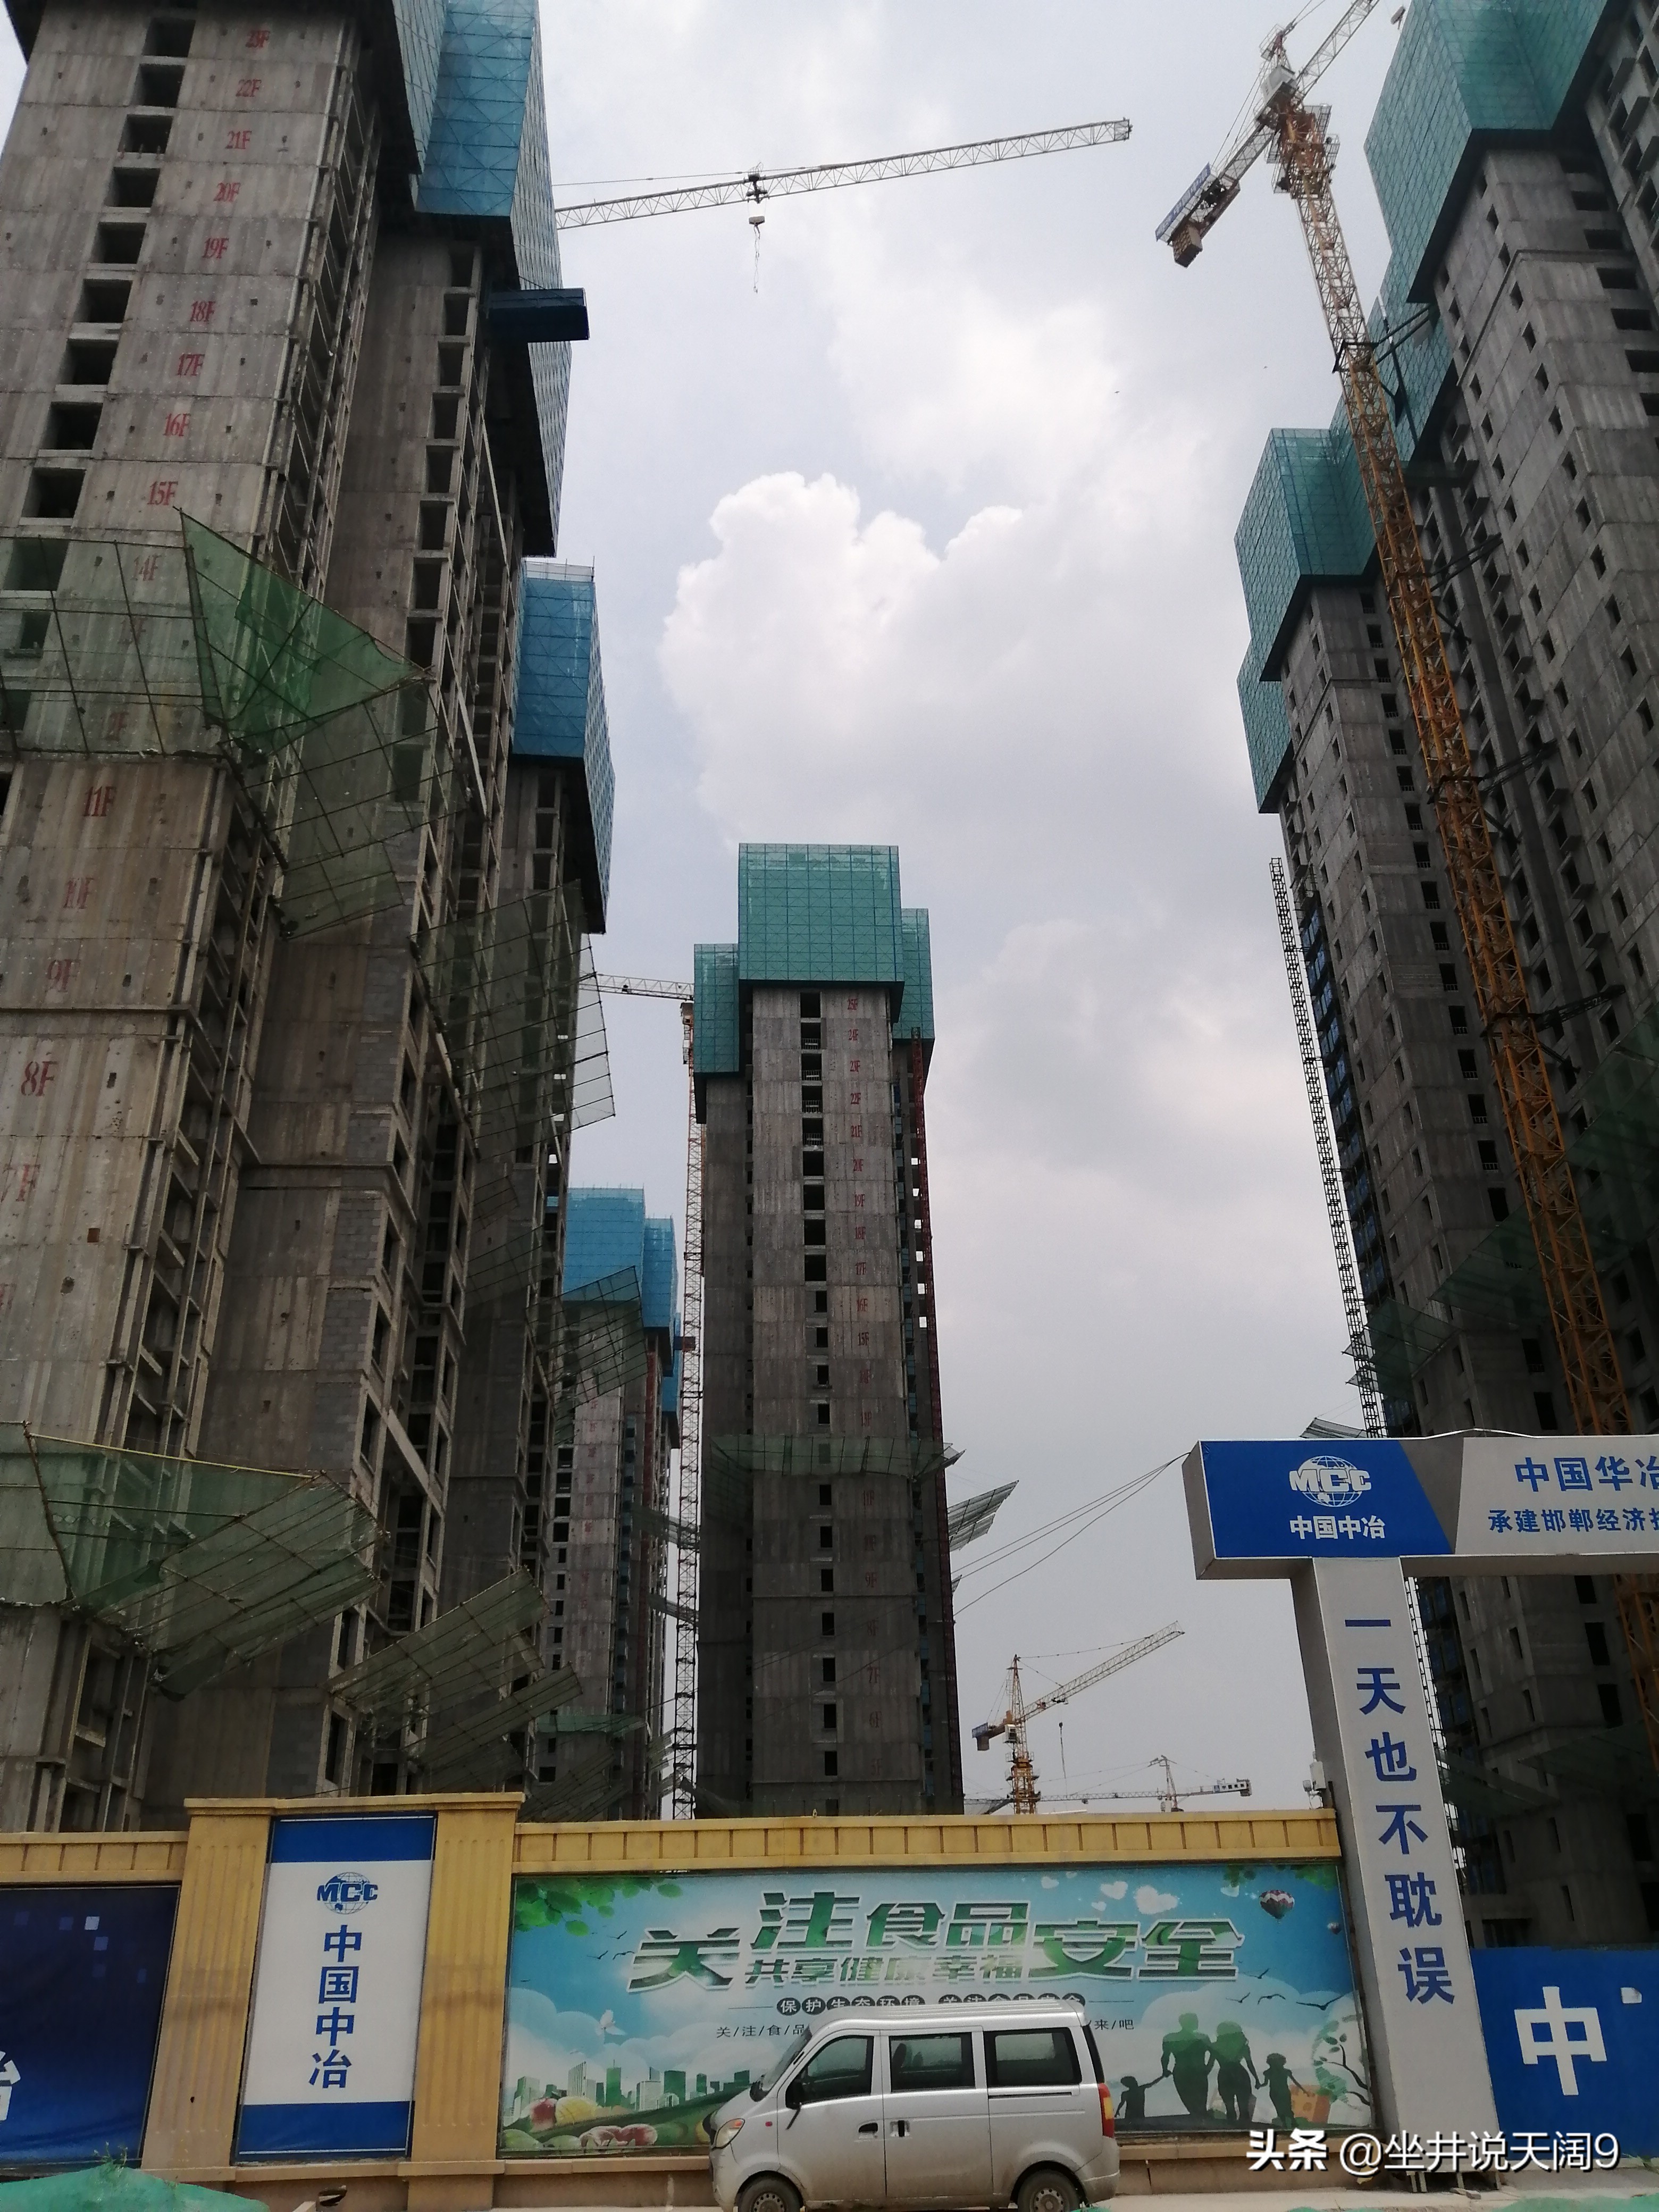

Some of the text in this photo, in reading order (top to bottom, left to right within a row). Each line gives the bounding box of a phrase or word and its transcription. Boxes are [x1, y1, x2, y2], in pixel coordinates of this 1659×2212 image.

[236, 79, 262, 97] 22F
[224, 130, 252, 150] 21F
[214, 182, 241, 203] 20F
[202, 238, 229, 259] 19F
[189, 301, 216, 322] 18F
[178, 354, 205, 376] 17F
[163, 413, 191, 437] 16F
[147, 481, 179, 506] 15F
[83, 786, 116, 817] 11F
[21, 1061, 57, 1096] 8F
[851, 1093, 861, 1105] 22F
[851, 1125, 862, 1137] 21F
[854, 1194, 865, 1207] 19F
[855, 1227, 866, 1239] 18F
[855, 1262, 867, 1275] 17F
[856, 1298, 868, 1312] 16F
[858, 1333, 869, 1346] 15F
[1289, 1469, 1372, 1492] MCC
[1514, 1455, 1659, 1492] 中国华冶
[1289, 1515, 1385, 1539] 中国中冶
[865, 1572, 877, 1588] 9F
[866, 1666, 880, 1684] 7F
[1345, 1619, 1455, 2005] 一天也不耽误
[317, 1883, 378, 1903] MCC
[627, 1891, 1245, 1993] 关注食品安全
[745, 1955, 1023, 1988] 共享健康幸福
[308, 1924, 362, 2089] 中国中冶
[1514, 1986, 1608, 2096] 中
